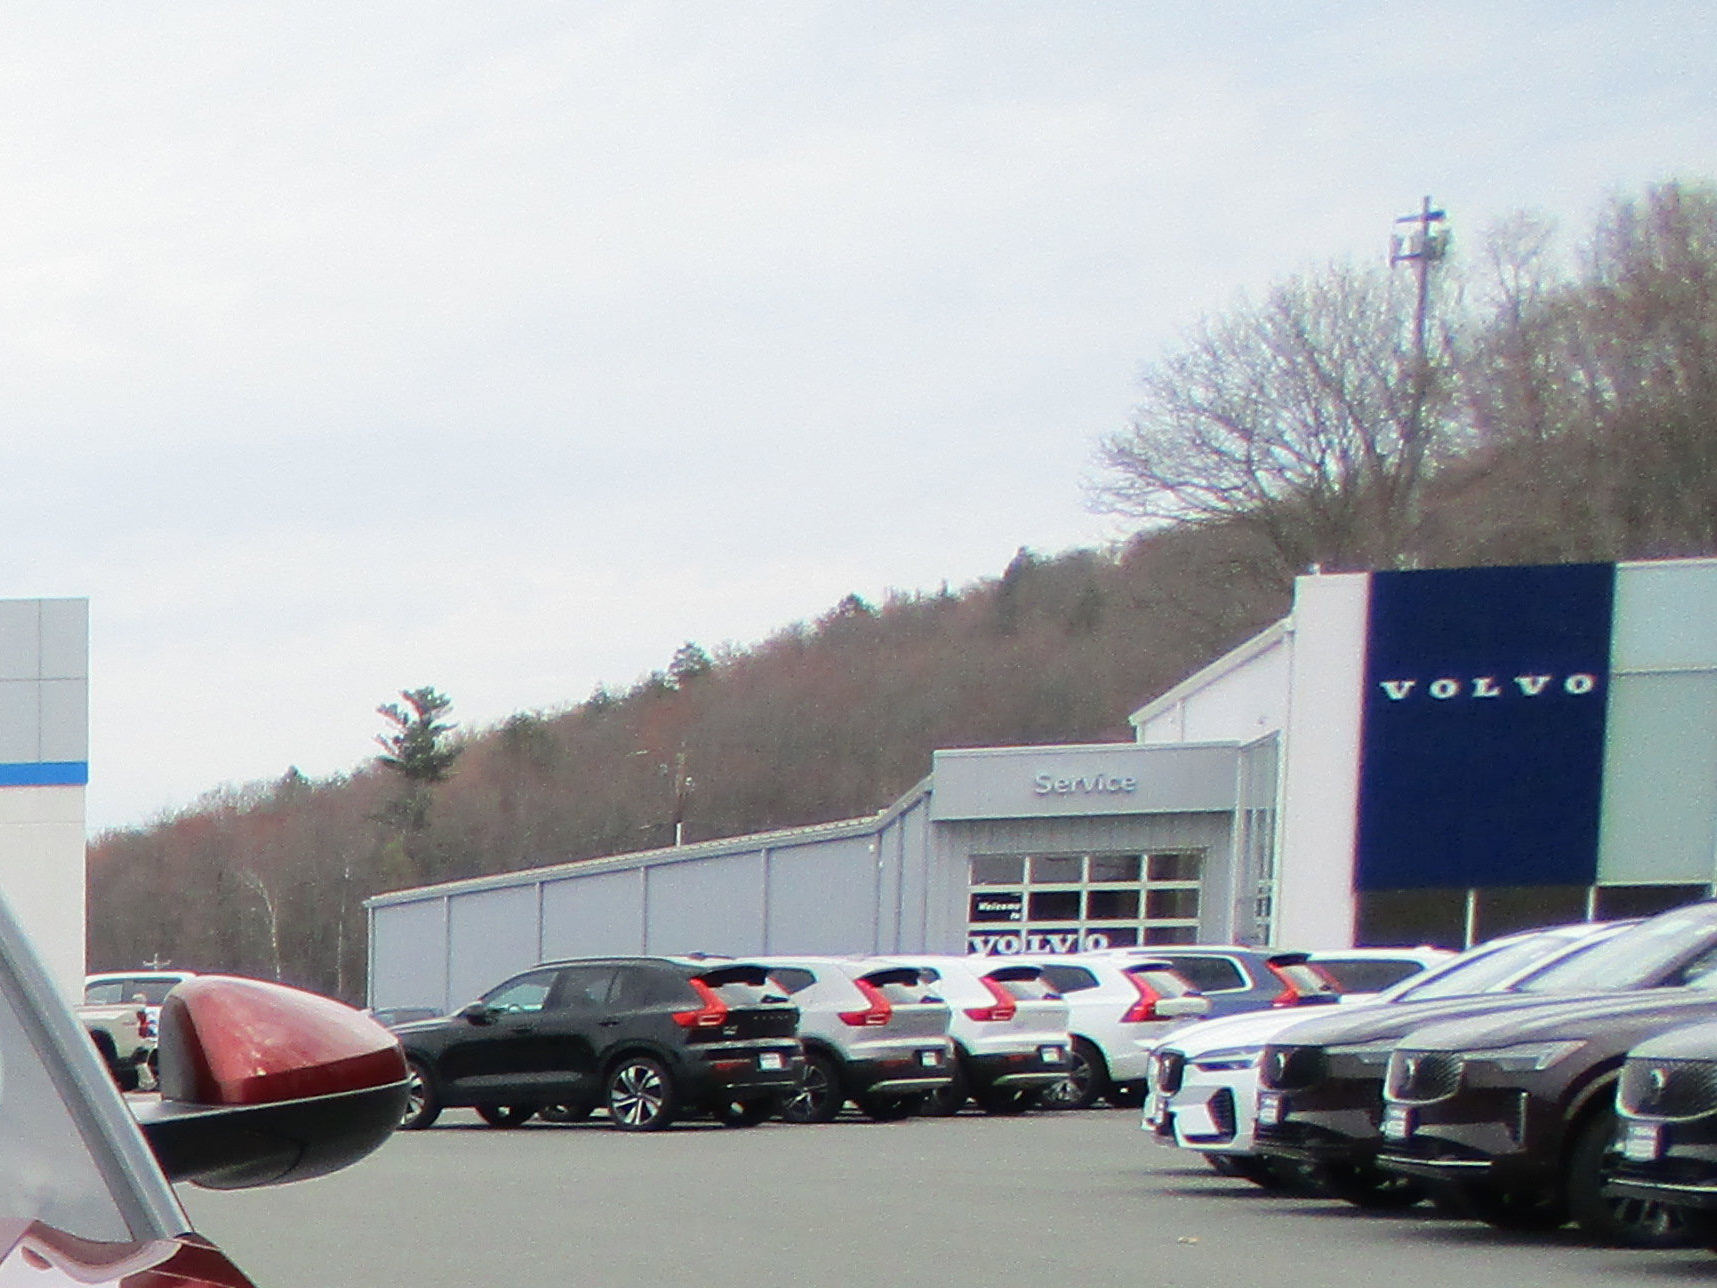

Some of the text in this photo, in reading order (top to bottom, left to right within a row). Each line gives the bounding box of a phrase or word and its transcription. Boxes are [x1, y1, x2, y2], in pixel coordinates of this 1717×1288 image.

[1379, 673, 1596, 700] VOLVO
[1034, 773, 1138, 794] Service
[968, 934, 1109, 954] VOLVO
